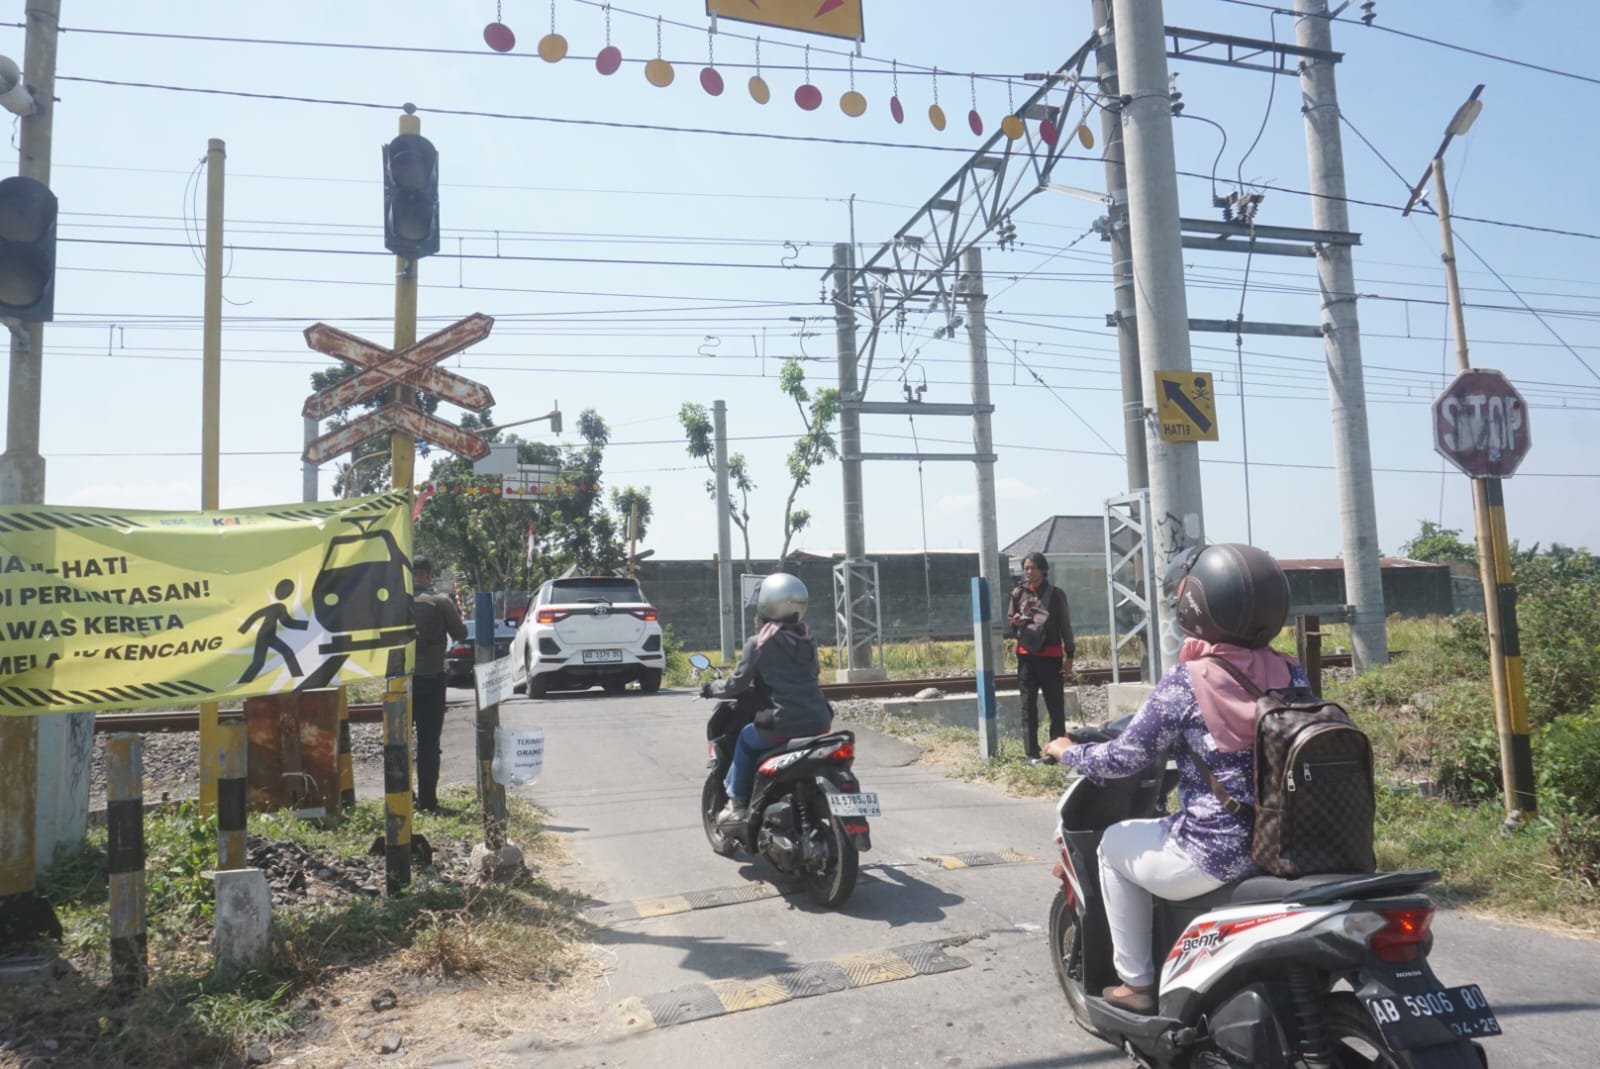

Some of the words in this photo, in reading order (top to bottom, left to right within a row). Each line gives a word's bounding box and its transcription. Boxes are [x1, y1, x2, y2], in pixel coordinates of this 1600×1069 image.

[1441, 394, 1522, 452] STOP
[20, 580, 211, 606] PERLINTASAN!
[84, 614, 185, 635] KERETA
[104, 636, 224, 661] KENCANG
[1396, 970, 1422, 978] HONDA
[1372, 999, 1401, 1025] AB
[1403, 991, 1454, 1017] 5906
